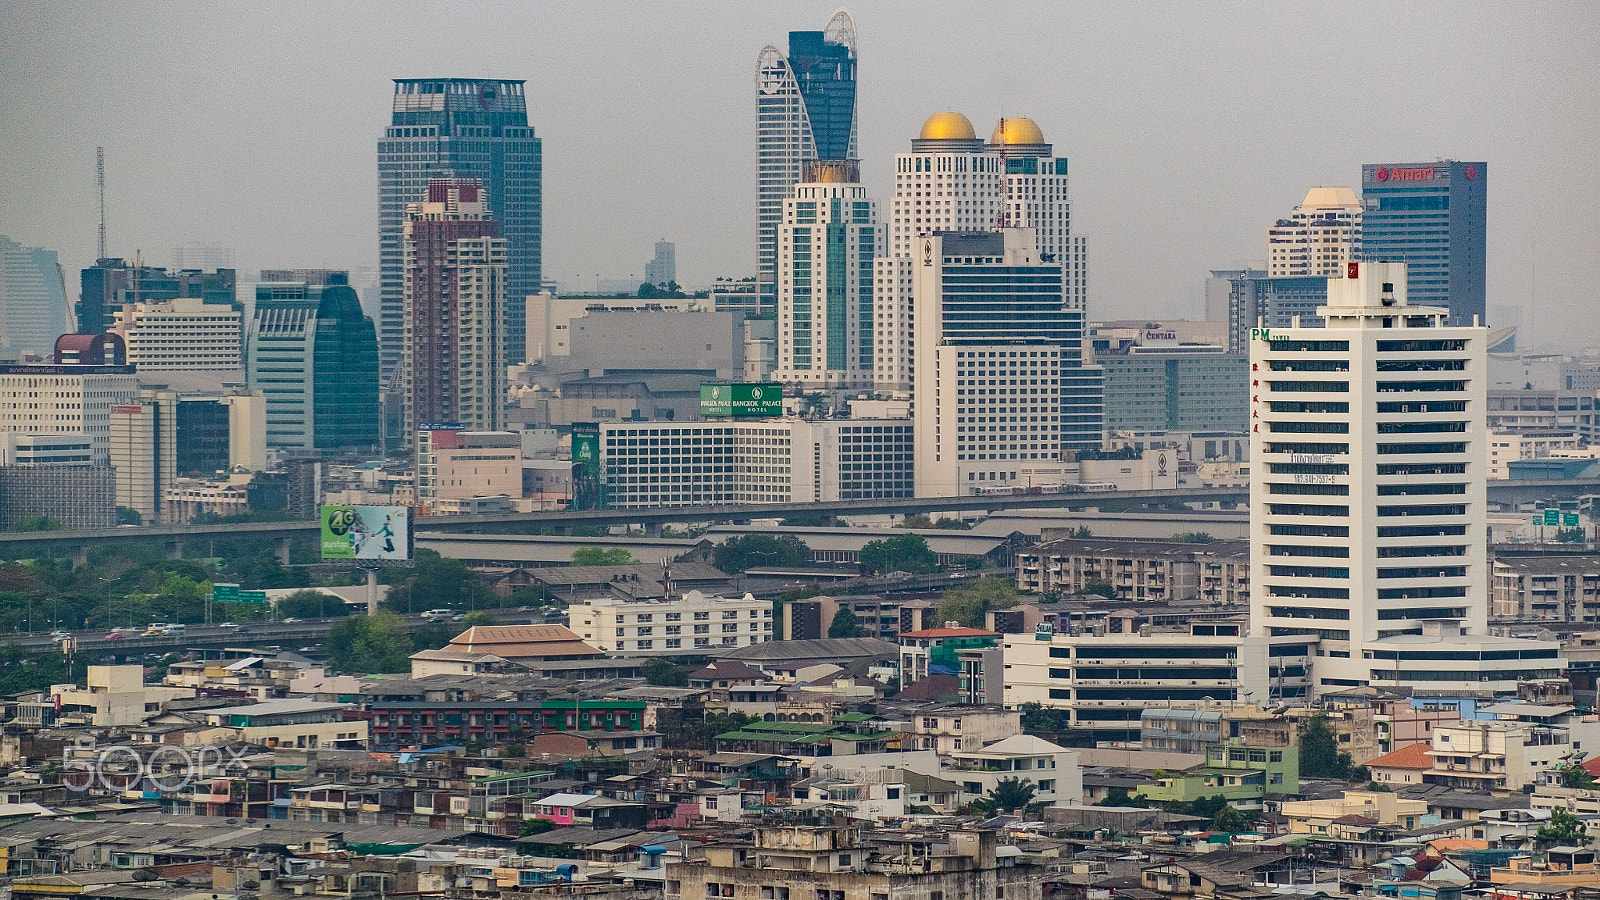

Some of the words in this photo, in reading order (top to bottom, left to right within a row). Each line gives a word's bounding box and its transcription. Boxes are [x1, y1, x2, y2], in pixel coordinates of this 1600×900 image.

[1390, 167, 1434, 181] Amari
[1252, 329, 1270, 340] PM
[329, 509, 354, 535] 4G
